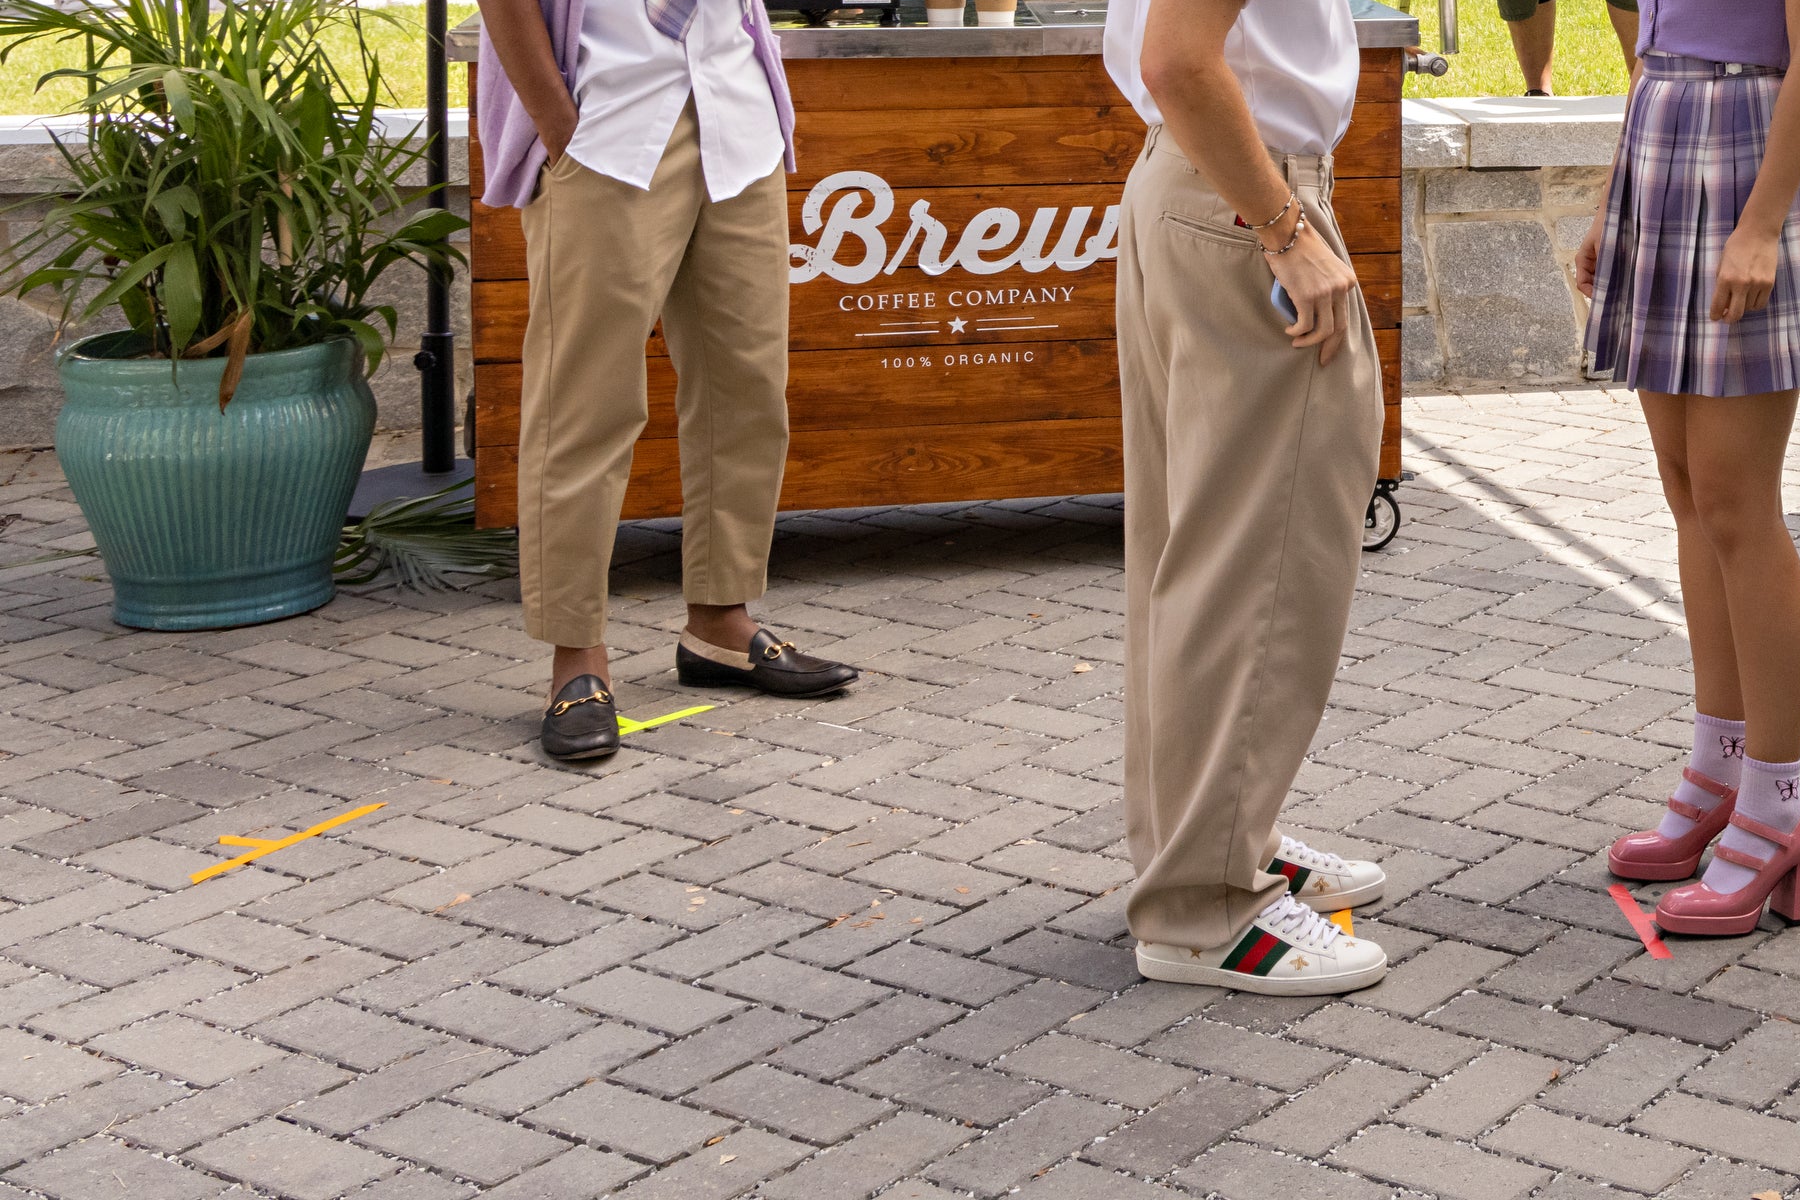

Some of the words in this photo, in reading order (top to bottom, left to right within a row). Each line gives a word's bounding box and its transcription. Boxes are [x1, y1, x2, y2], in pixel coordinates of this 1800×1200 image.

[788, 170, 1121, 285] Brew
[839, 292, 936, 311] COFFEE
[948, 286, 1075, 307] COMPANY
[881, 356, 932, 369] 100%
[944, 351, 1034, 366] ORGANIC
